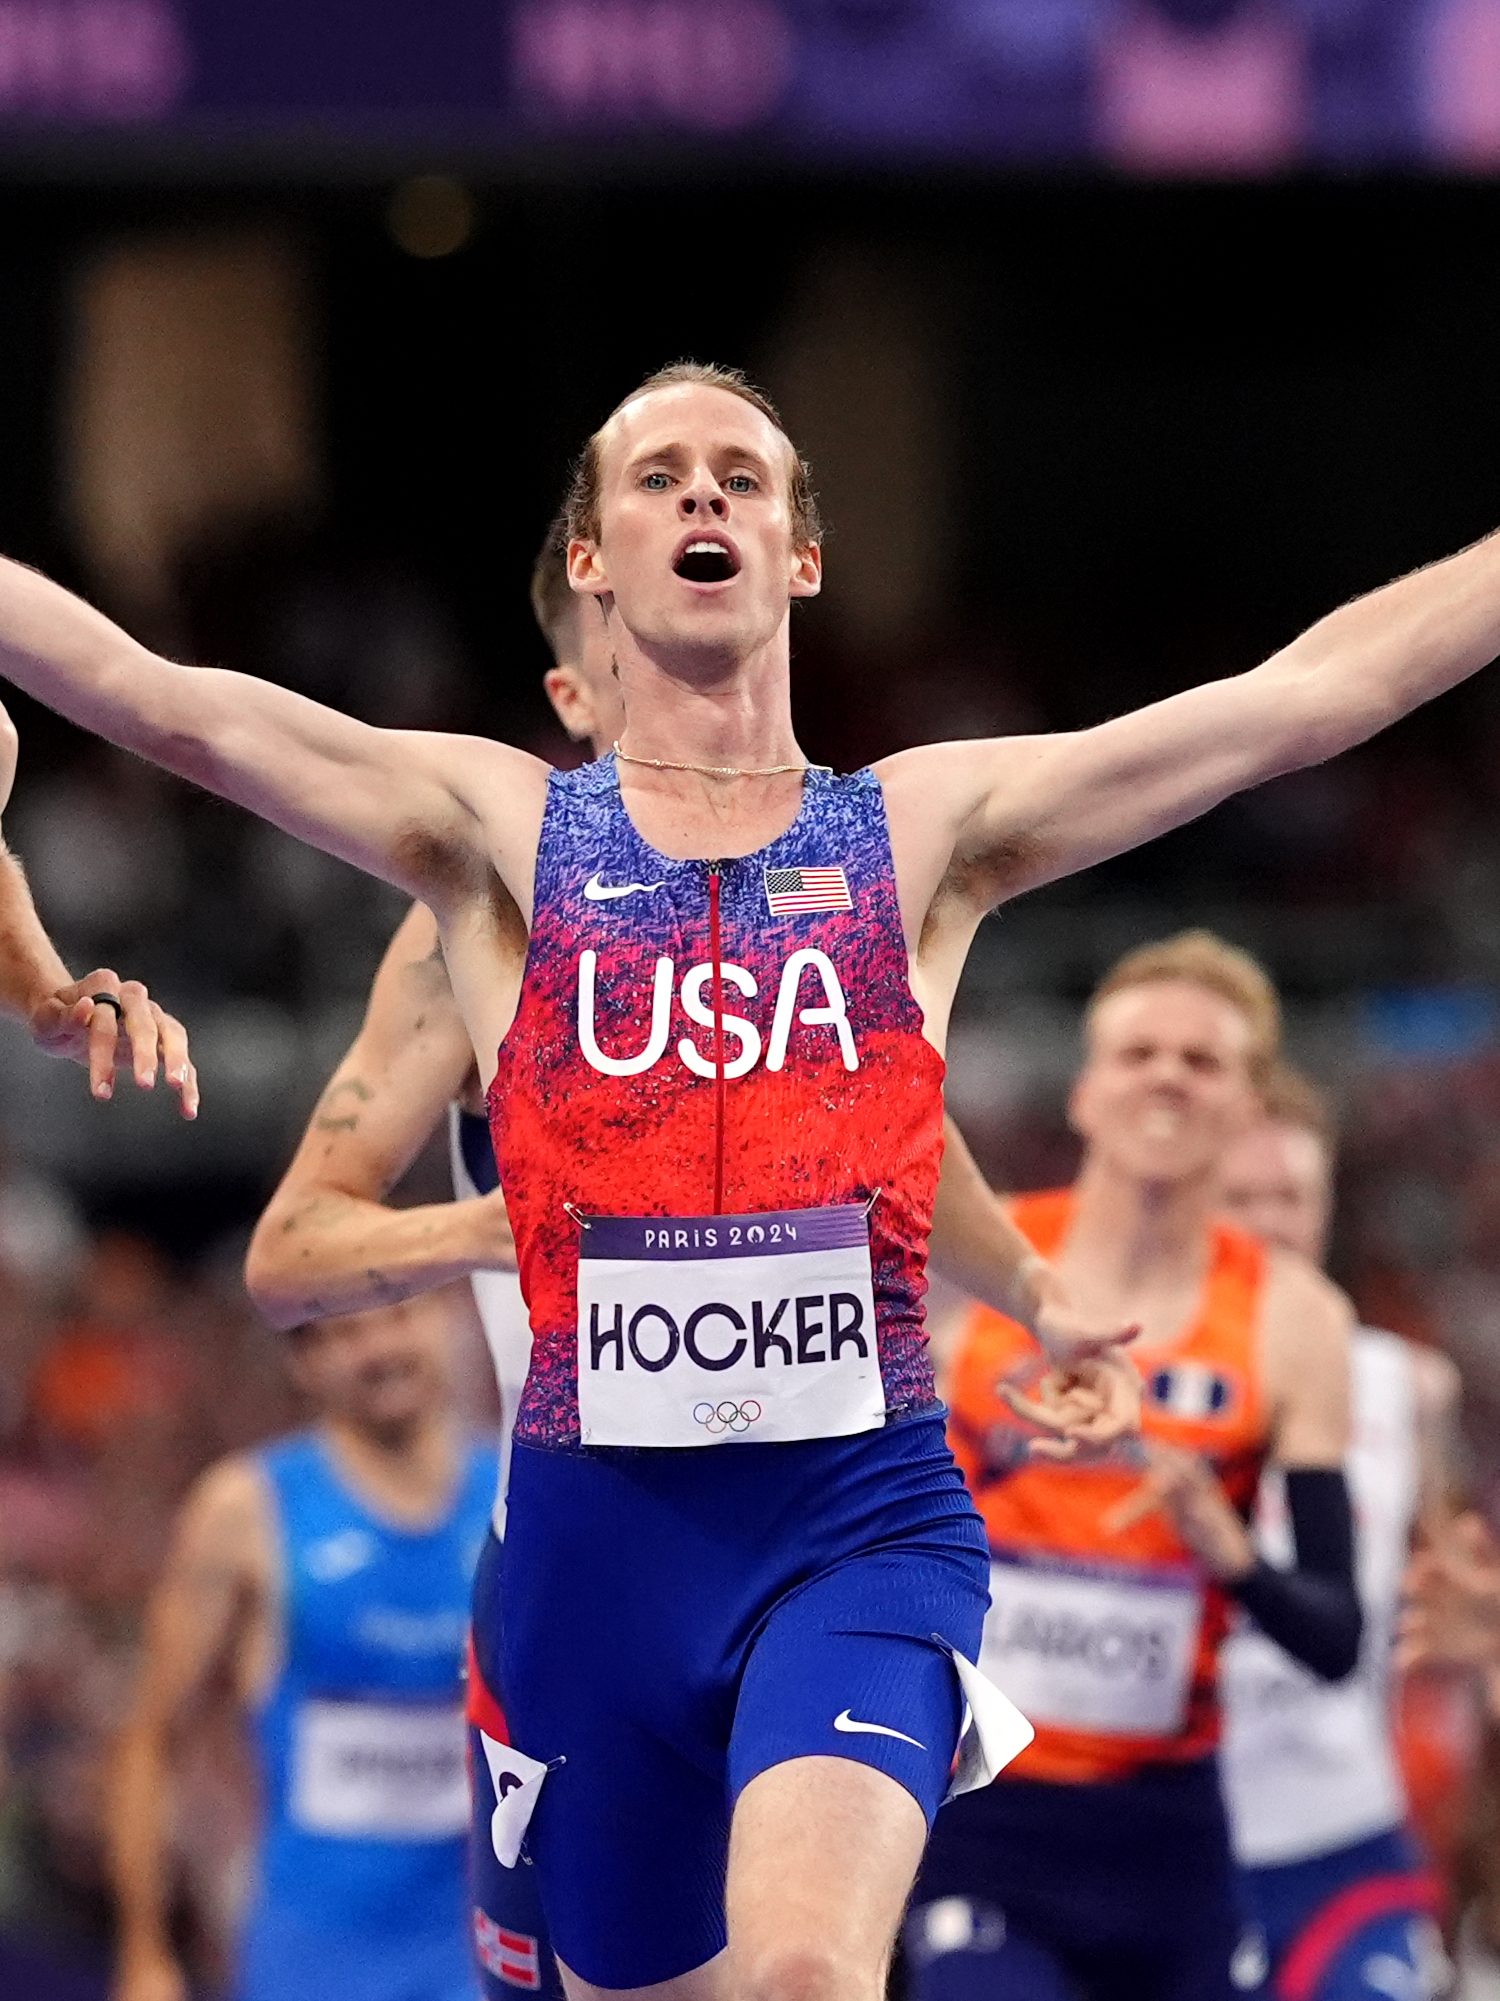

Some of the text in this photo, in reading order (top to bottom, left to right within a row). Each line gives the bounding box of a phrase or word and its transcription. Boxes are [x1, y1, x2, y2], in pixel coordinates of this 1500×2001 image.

[578, 948, 860, 1080] USA
[645, 1222, 797, 1249] PARIS 2024
[590, 1292, 869, 1373] HOCKER
